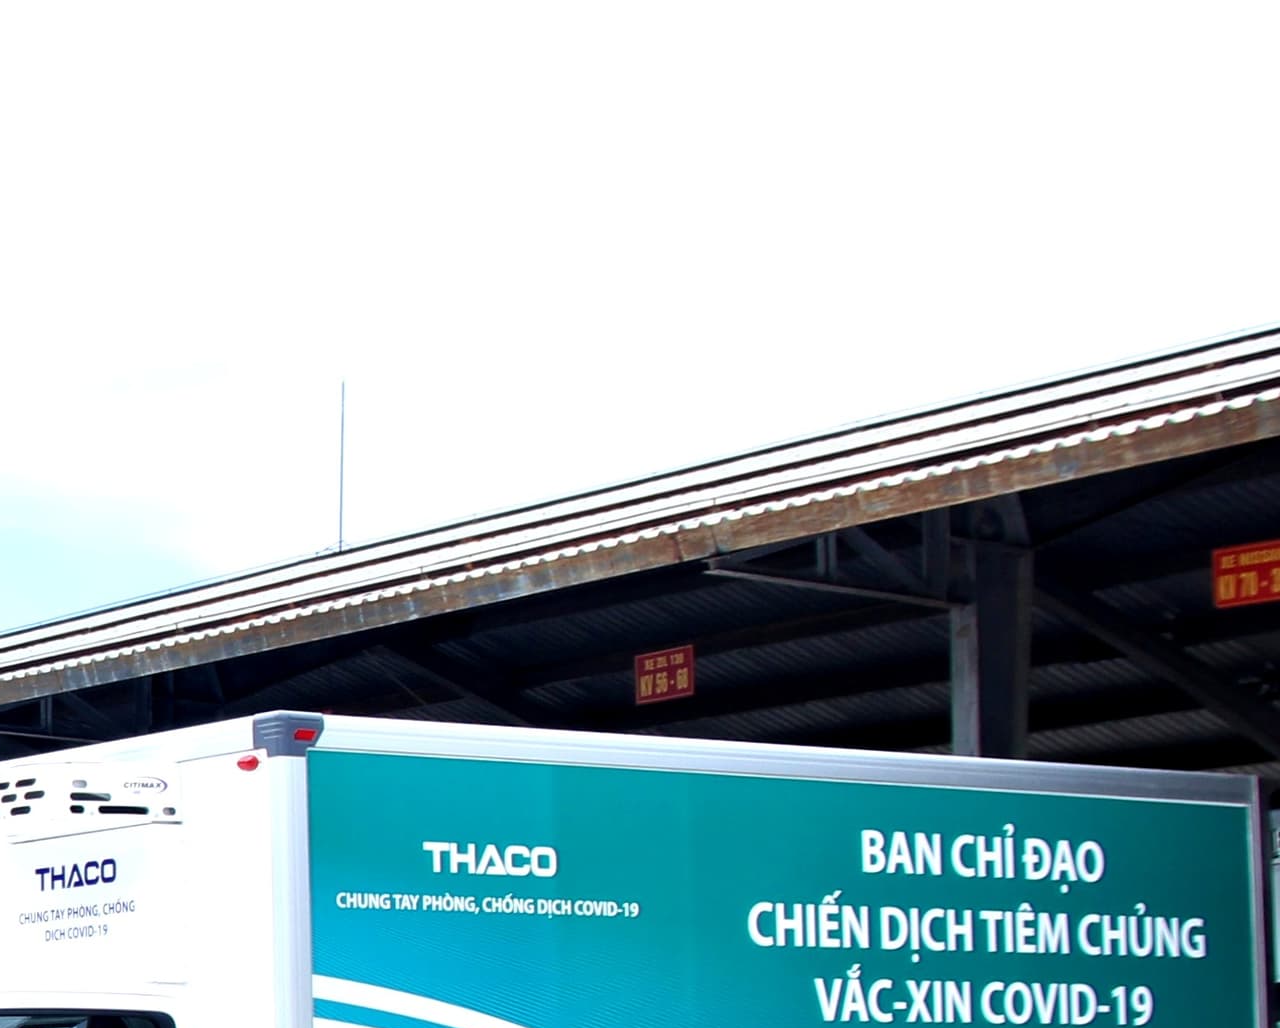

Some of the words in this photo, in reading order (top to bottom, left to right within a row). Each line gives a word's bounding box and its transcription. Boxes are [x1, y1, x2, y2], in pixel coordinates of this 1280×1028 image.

[35, 858, 117, 892] THACO
[422, 840, 558, 877] THACO
[861, 829, 942, 876] BAN
[951, 823, 1016, 879] CHỈ
[1022, 838, 1105, 894] ĐẠO
[19, 910, 49, 925] CHUNG
[50, 908, 65, 921] TAY
[336, 891, 391, 911] CHUNG
[391, 893, 420, 911] TAY
[422, 891, 480, 915] PHÒNG,
[482, 892, 534, 915] CHỐNG
[537, 898, 572, 919] DỊCH
[573, 899, 640, 918] COVID-19
[67, 923, 108, 940] COVID-19
[747, 889, 871, 949] CHIẾN
[880, 907, 974, 963] DỊCH
[979, 902, 1070, 955] TIÊM
[1077, 902, 1208, 959] CHỦNG
[814, 964, 972, 1024] VẮC-XIN
[980, 981, 1154, 1027] COVID-19
